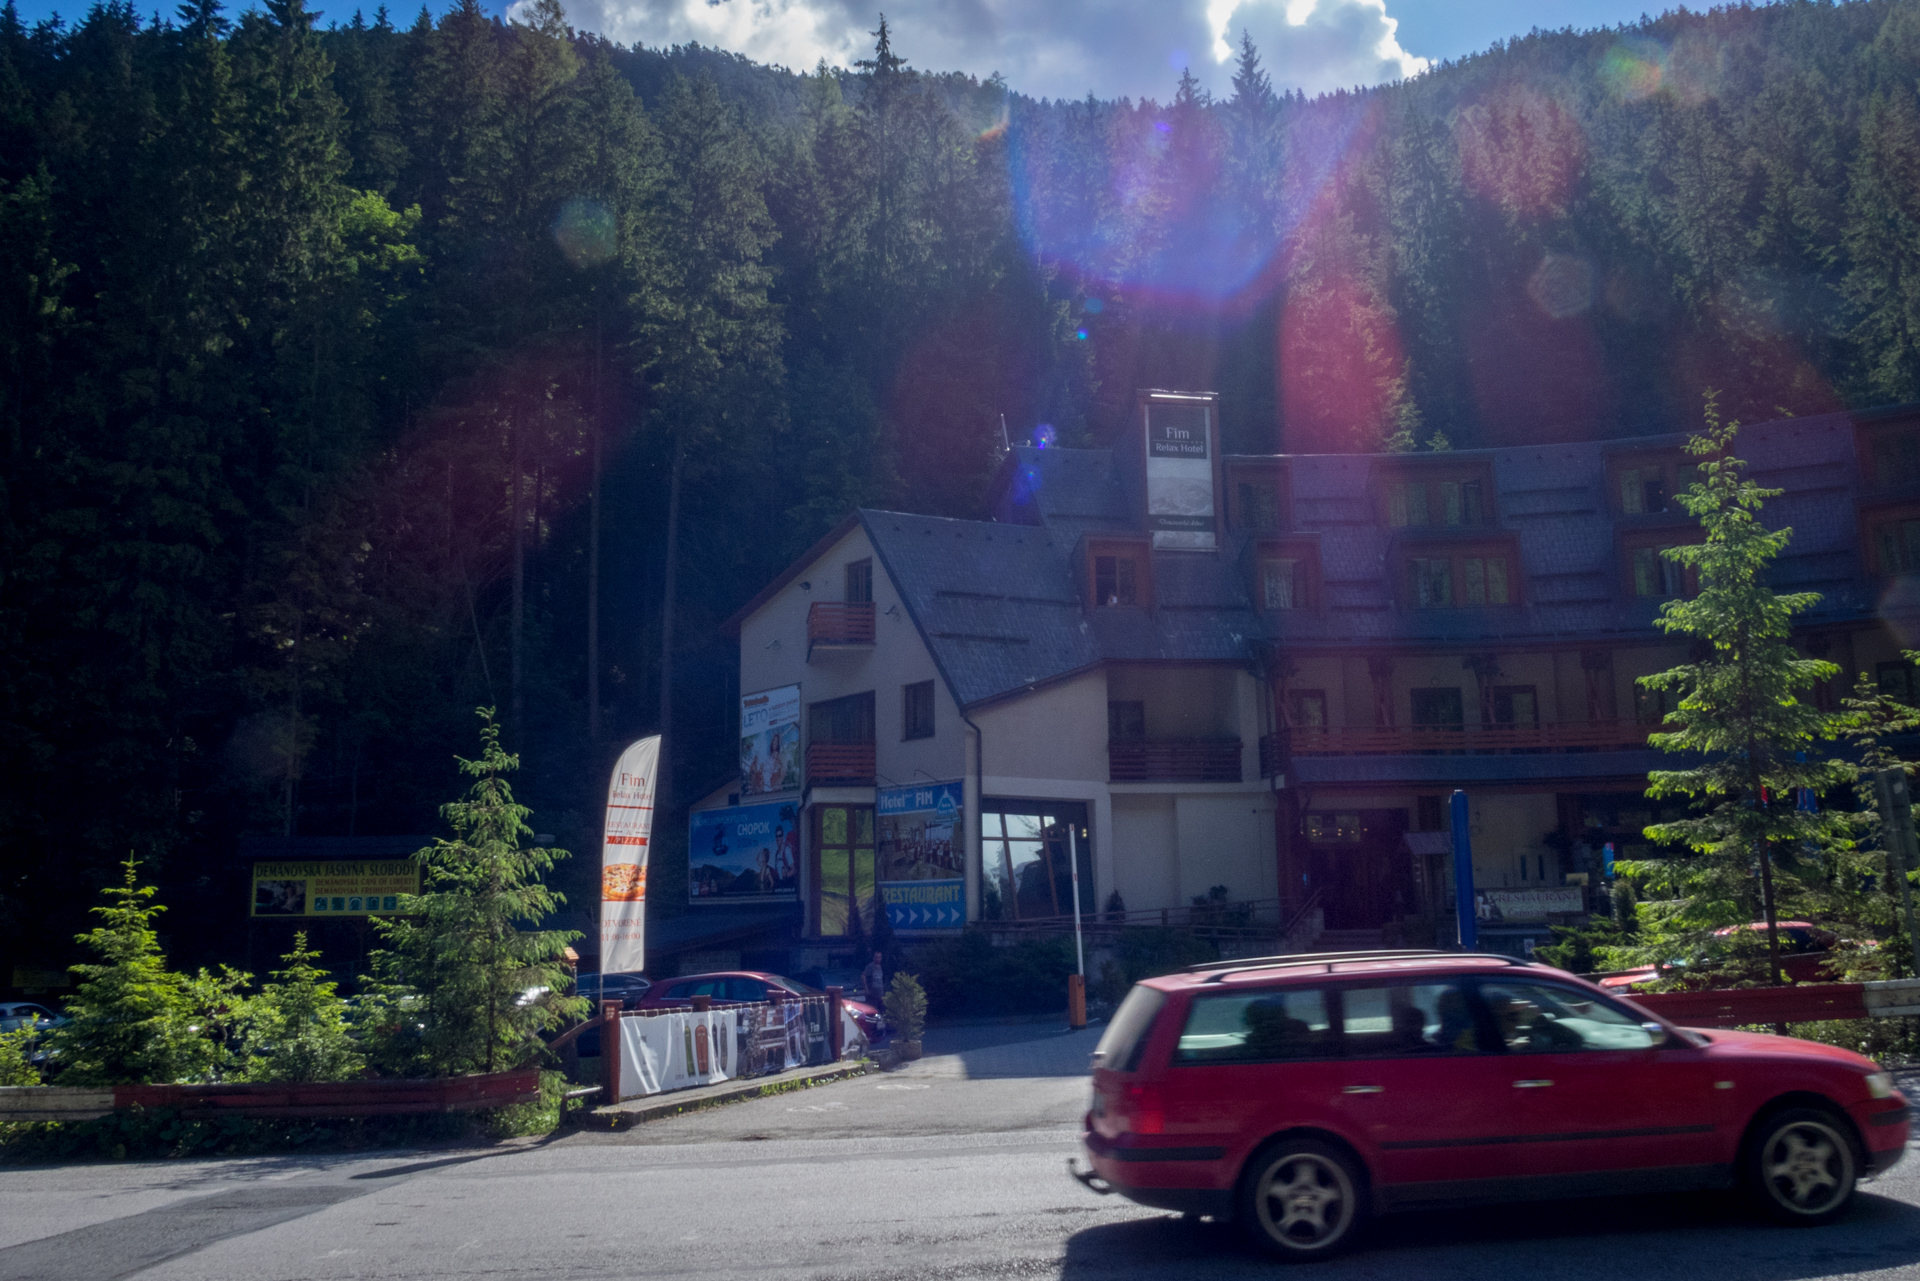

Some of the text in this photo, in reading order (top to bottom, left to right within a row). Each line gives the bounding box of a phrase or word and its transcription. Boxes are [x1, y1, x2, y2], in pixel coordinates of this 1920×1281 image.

[1165, 427, 1190, 440] Fim
[1156, 443, 1204, 453] Relax Hotel
[743, 708, 768, 728] LETO
[621, 773, 645, 787] Fim
[880, 790, 933, 811] Hotel FIM
[737, 821, 770, 836] CHOPOK
[615, 837, 640, 845] PIZZA
[882, 885, 960, 905] RESTAURANT
[1498, 891, 1579, 902] RESTAURANT
